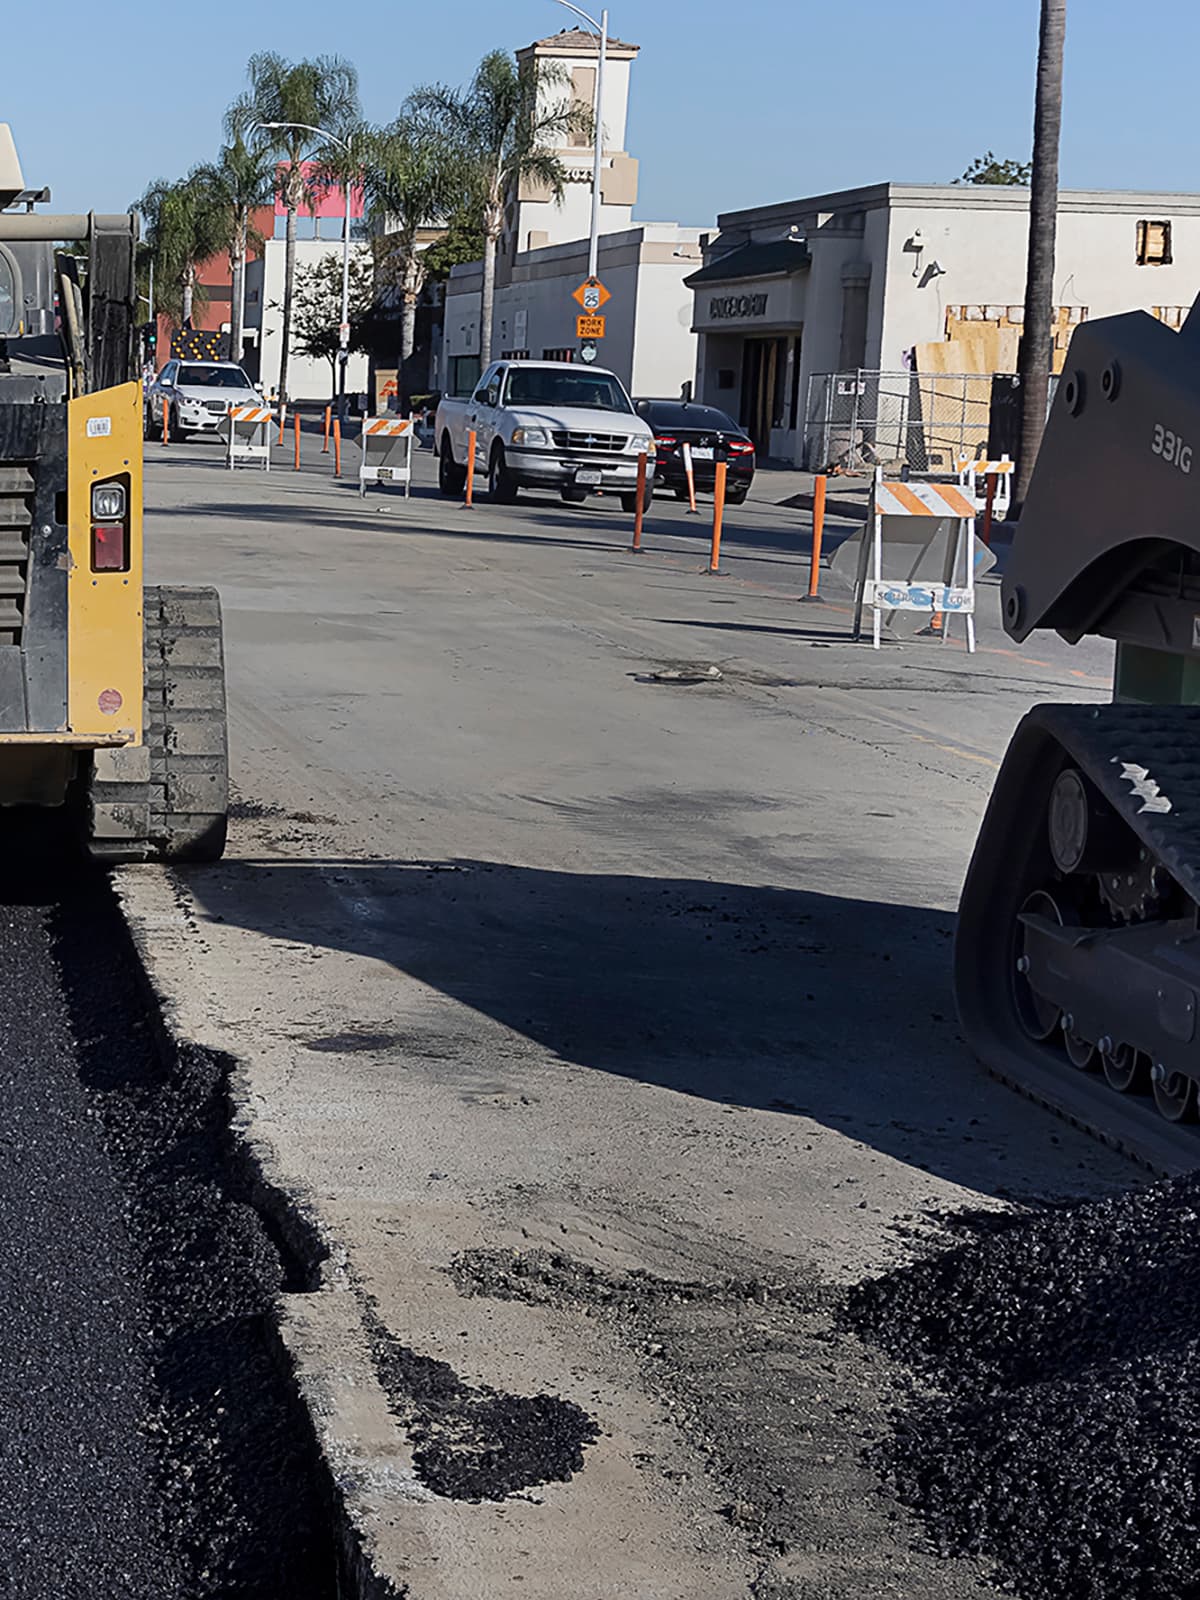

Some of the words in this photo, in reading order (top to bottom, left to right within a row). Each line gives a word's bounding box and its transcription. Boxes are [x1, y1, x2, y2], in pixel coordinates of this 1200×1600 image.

[585, 295, 599, 307] 25
[580, 319, 601, 327] WORK
[580, 327, 601, 335] ZONE
[1151, 423, 1192, 473] 331G
